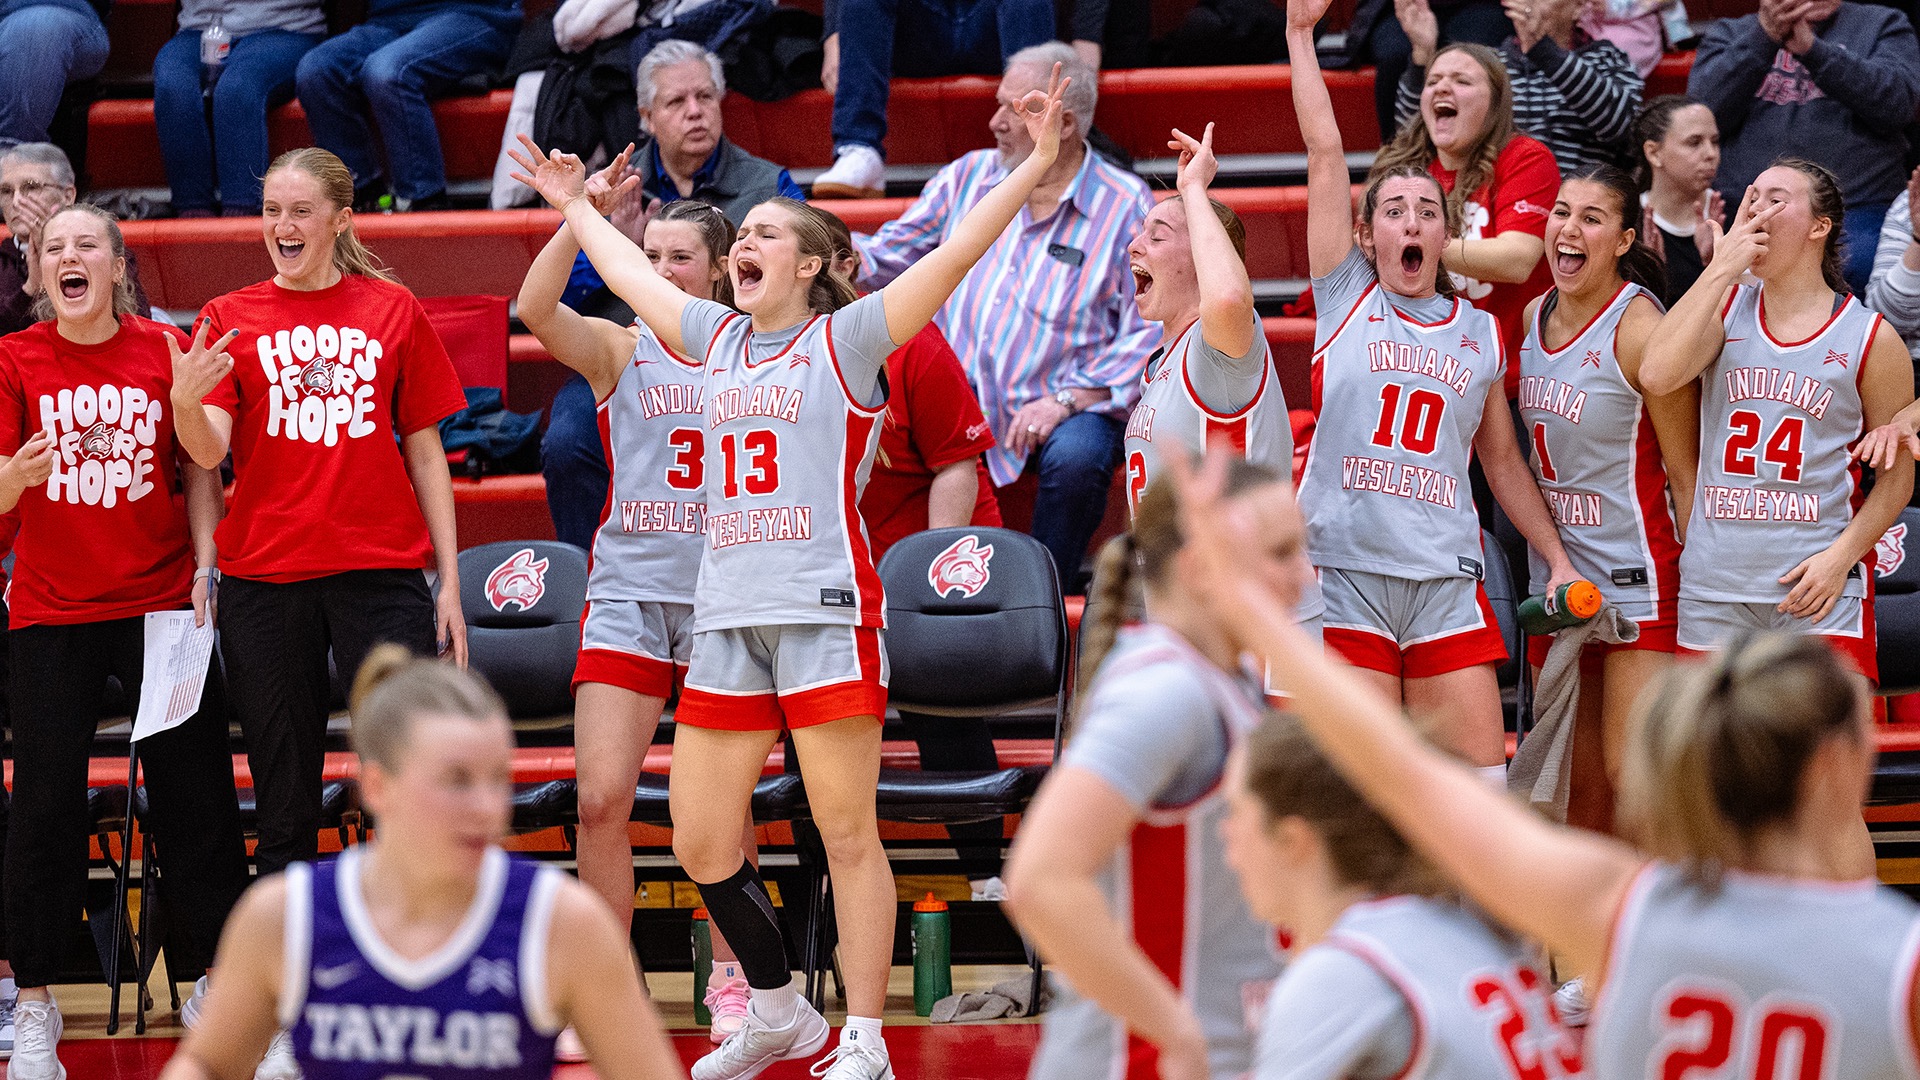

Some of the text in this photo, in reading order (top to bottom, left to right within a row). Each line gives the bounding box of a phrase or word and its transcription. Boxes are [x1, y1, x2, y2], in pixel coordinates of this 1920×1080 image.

[257, 324, 383, 384] HOOPS
[1368, 340, 1473, 399] INDIANA
[39, 384, 162, 447] HOOPS
[267, 384, 376, 447] HOPE
[709, 385, 803, 430] INDIANA
[1370, 381, 1447, 456] 10
[1725, 366, 1834, 421] INDIANA
[665, 426, 705, 492] 3
[719, 427, 781, 501] 13
[1533, 421, 1558, 484] 1
[1722, 408, 1806, 484] 24
[46, 447, 154, 509] HOPE
[1342, 456, 1457, 509] WESLEYAN
[1704, 486, 1820, 522] WESLEYAN
[709, 507, 811, 550] WESLEYAN
[306, 1003, 522, 1068] TAYLOR
